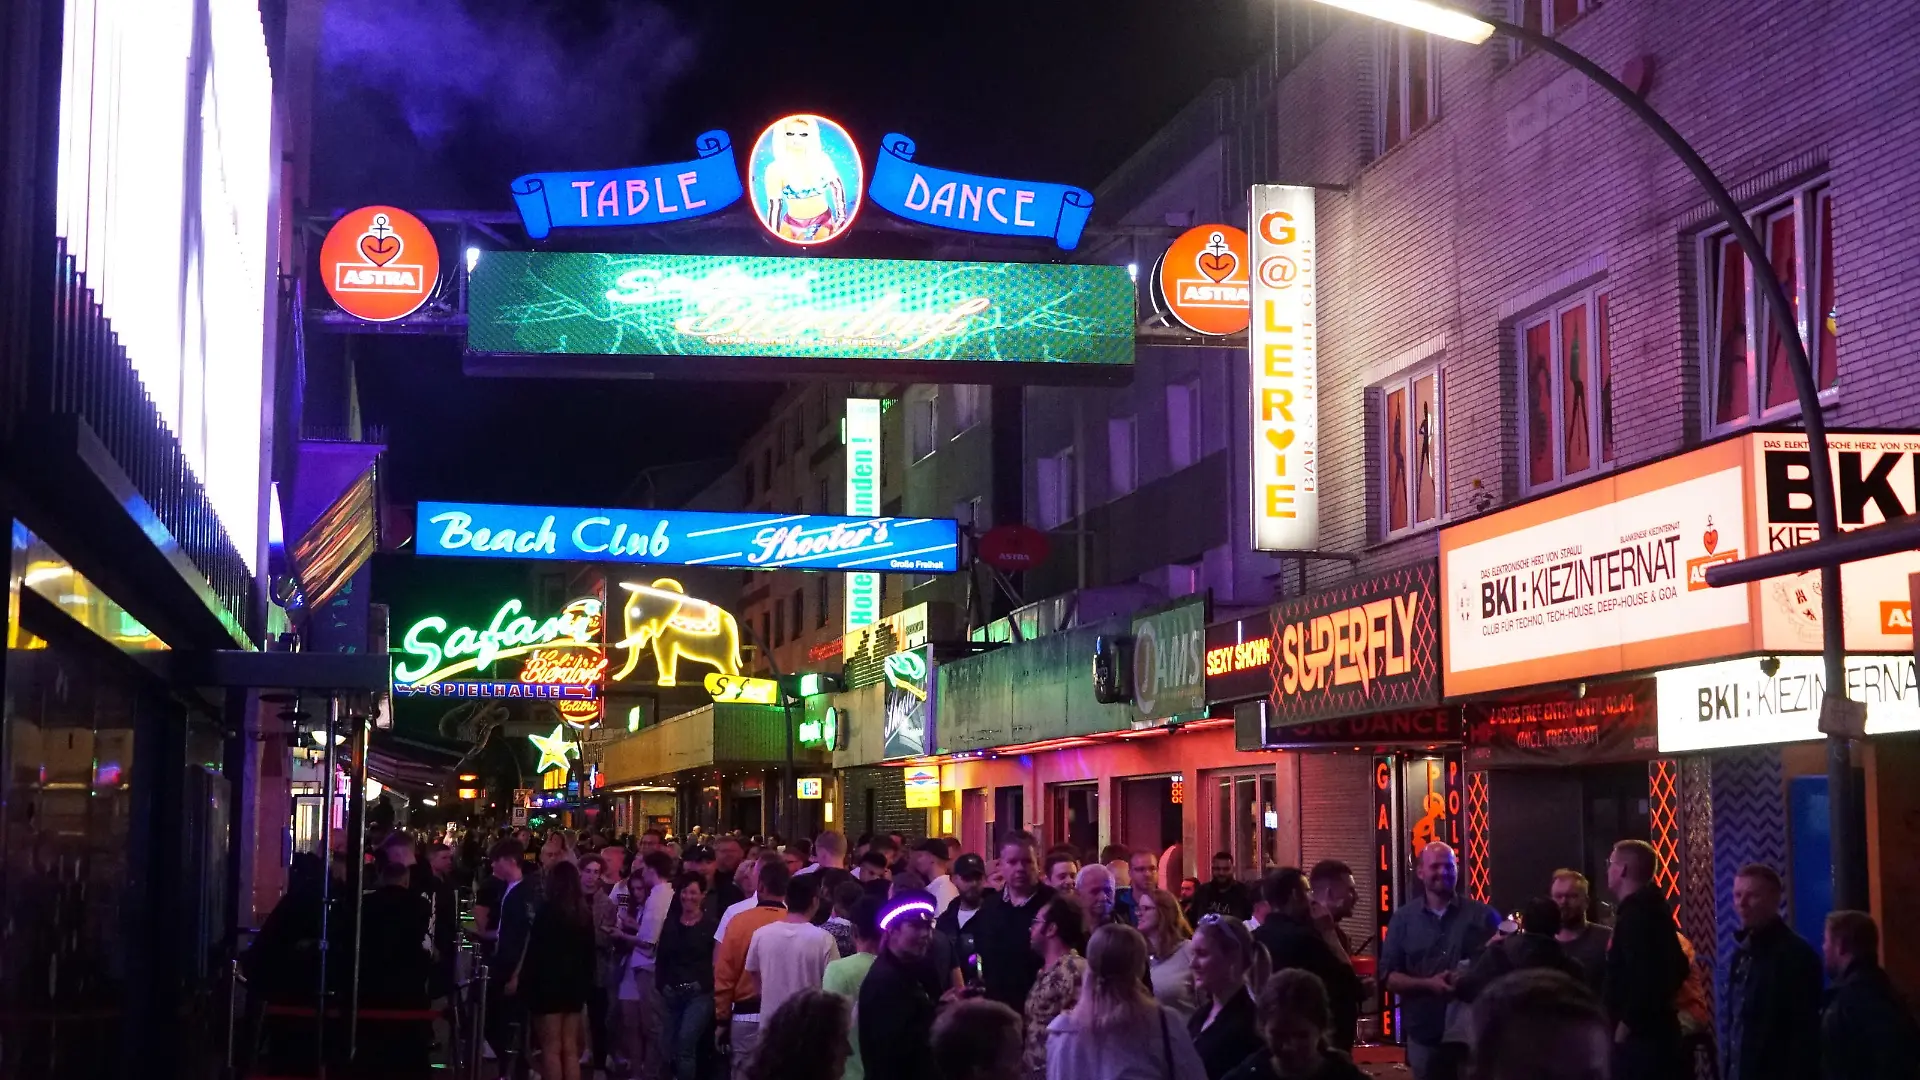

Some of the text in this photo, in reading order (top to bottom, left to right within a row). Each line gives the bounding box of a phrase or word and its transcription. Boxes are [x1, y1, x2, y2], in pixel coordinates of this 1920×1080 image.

[571, 171, 706, 217] TABLE
[905, 173, 1036, 227] DANCE
[343, 270, 416, 286] ASTRA
[1183, 286, 1250, 302] ASTRA
[1303, 441, 1314, 492] BAR
[1764, 441, 1781, 449] DAS
[1784, 441, 1851, 450] ELEKTISCHE
[1854, 442, 1877, 450] HERZ
[1880, 442, 1901, 450] VON
[851, 449, 873, 516] unden
[429, 511, 670, 557] Beach Club
[748, 520, 889, 563] Shooter's
[890, 559, 944, 570] Große Freiheit
[1480, 569, 1491, 580] DAS
[1492, 557, 1530, 577] ELEKTRONISCHE
[1531, 554, 1544, 567] HERZ
[1545, 550, 1559, 563] VON
[1532, 534, 1680, 609] KIEZINTERNAT
[851, 572, 873, 625] Hote
[1482, 586, 1678, 636] CLUB FÜR TECHNO, TECH-HOUSE, DEEP-HOUSE & GOA
[395, 598, 602, 682] Safari
[1206, 646, 1234, 676] SEXY
[1283, 592, 1418, 699] SUPERFLY
[429, 684, 561, 699] SPIELHALLE
[520, 654, 608, 690] Bierdorf
[1489, 705, 1521, 725] LADIES
[1522, 703, 1543, 722] FREE
[1543, 700, 1574, 720] ENTRY
[1546, 727, 1569, 747] FREE
[1450, 761, 1460, 863] POL
